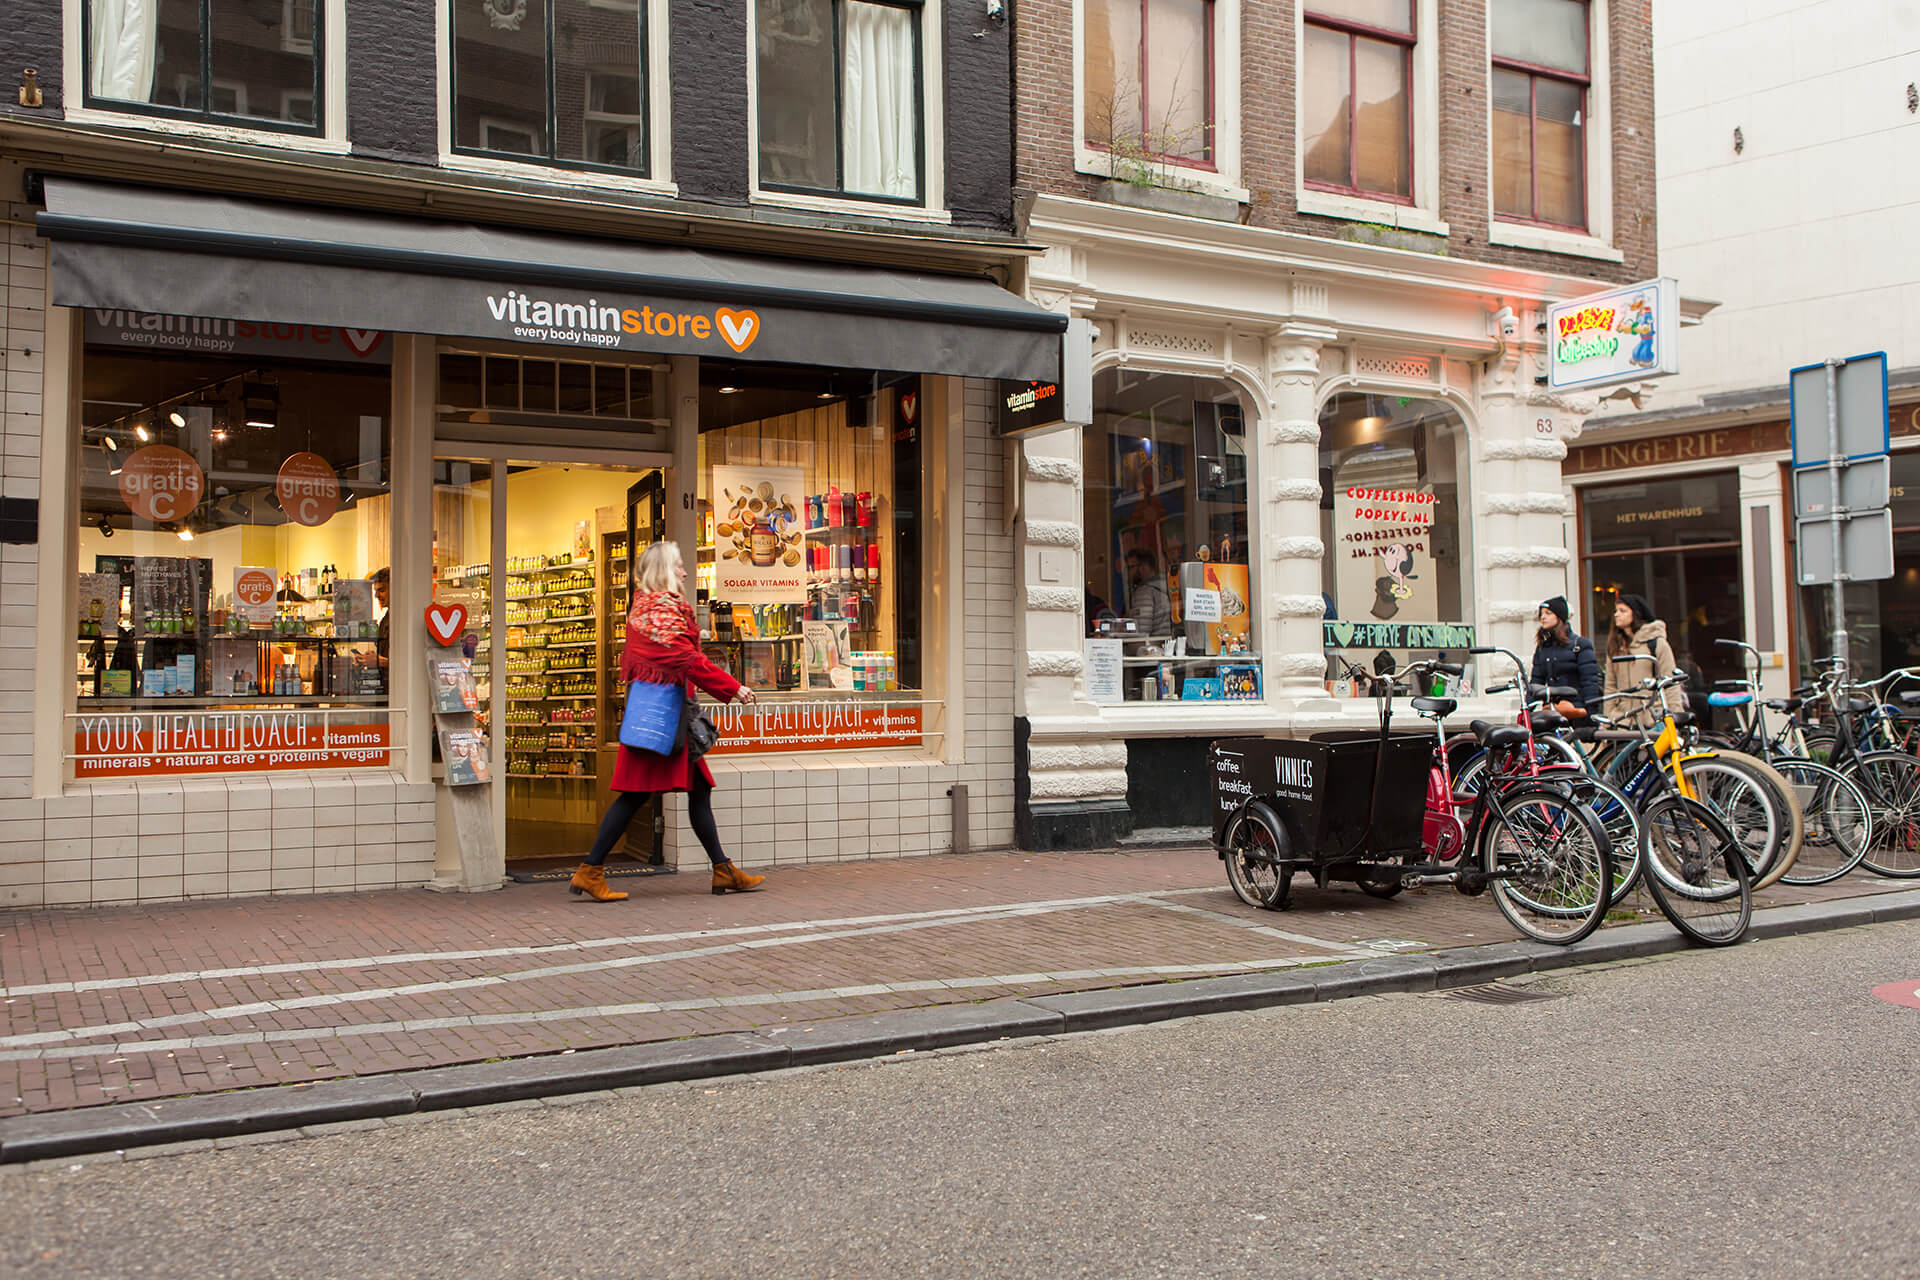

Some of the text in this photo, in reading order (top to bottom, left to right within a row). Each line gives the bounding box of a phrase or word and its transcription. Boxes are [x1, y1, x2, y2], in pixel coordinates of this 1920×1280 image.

[486, 290, 711, 339] vitaminstore
[1557, 307, 1616, 337] POPEYE
[120, 330, 235, 352] every body happy
[514, 326, 621, 347] every body happy
[1006, 384, 1056, 408] vitaminstore
[1536, 418, 1552, 433] 63
[1579, 430, 1732, 471] LINGERIE
[125, 471, 200, 494] gratis
[281, 477, 337, 499] gratis
[149, 492, 175, 519] C
[299, 497, 319, 524] C
[683, 492, 694, 510] 61
[1355, 507, 1429, 523] POPEYE.NL
[1616, 506, 1703, 523] HET WARENHUIS
[239, 582, 272, 593] gratis
[723, 579, 800, 587] SOLGAR VITAMINS
[249, 592, 261, 604] C
[872, 714, 916, 726] vitamins
[80, 716, 145, 752] YOUR
[323, 731, 381, 745] vitamins
[83, 755, 152, 769] minerals
[165, 753, 219, 767] natural
[222, 752, 256, 765] care
[341, 750, 384, 762] vegan
[1216, 758, 1241, 774] coffee
[1274, 755, 1313, 788] VINNIES
[1218, 776, 1253, 795] breakfast
[1276, 789, 1287, 798] good
[1288, 789, 1301, 800] home
